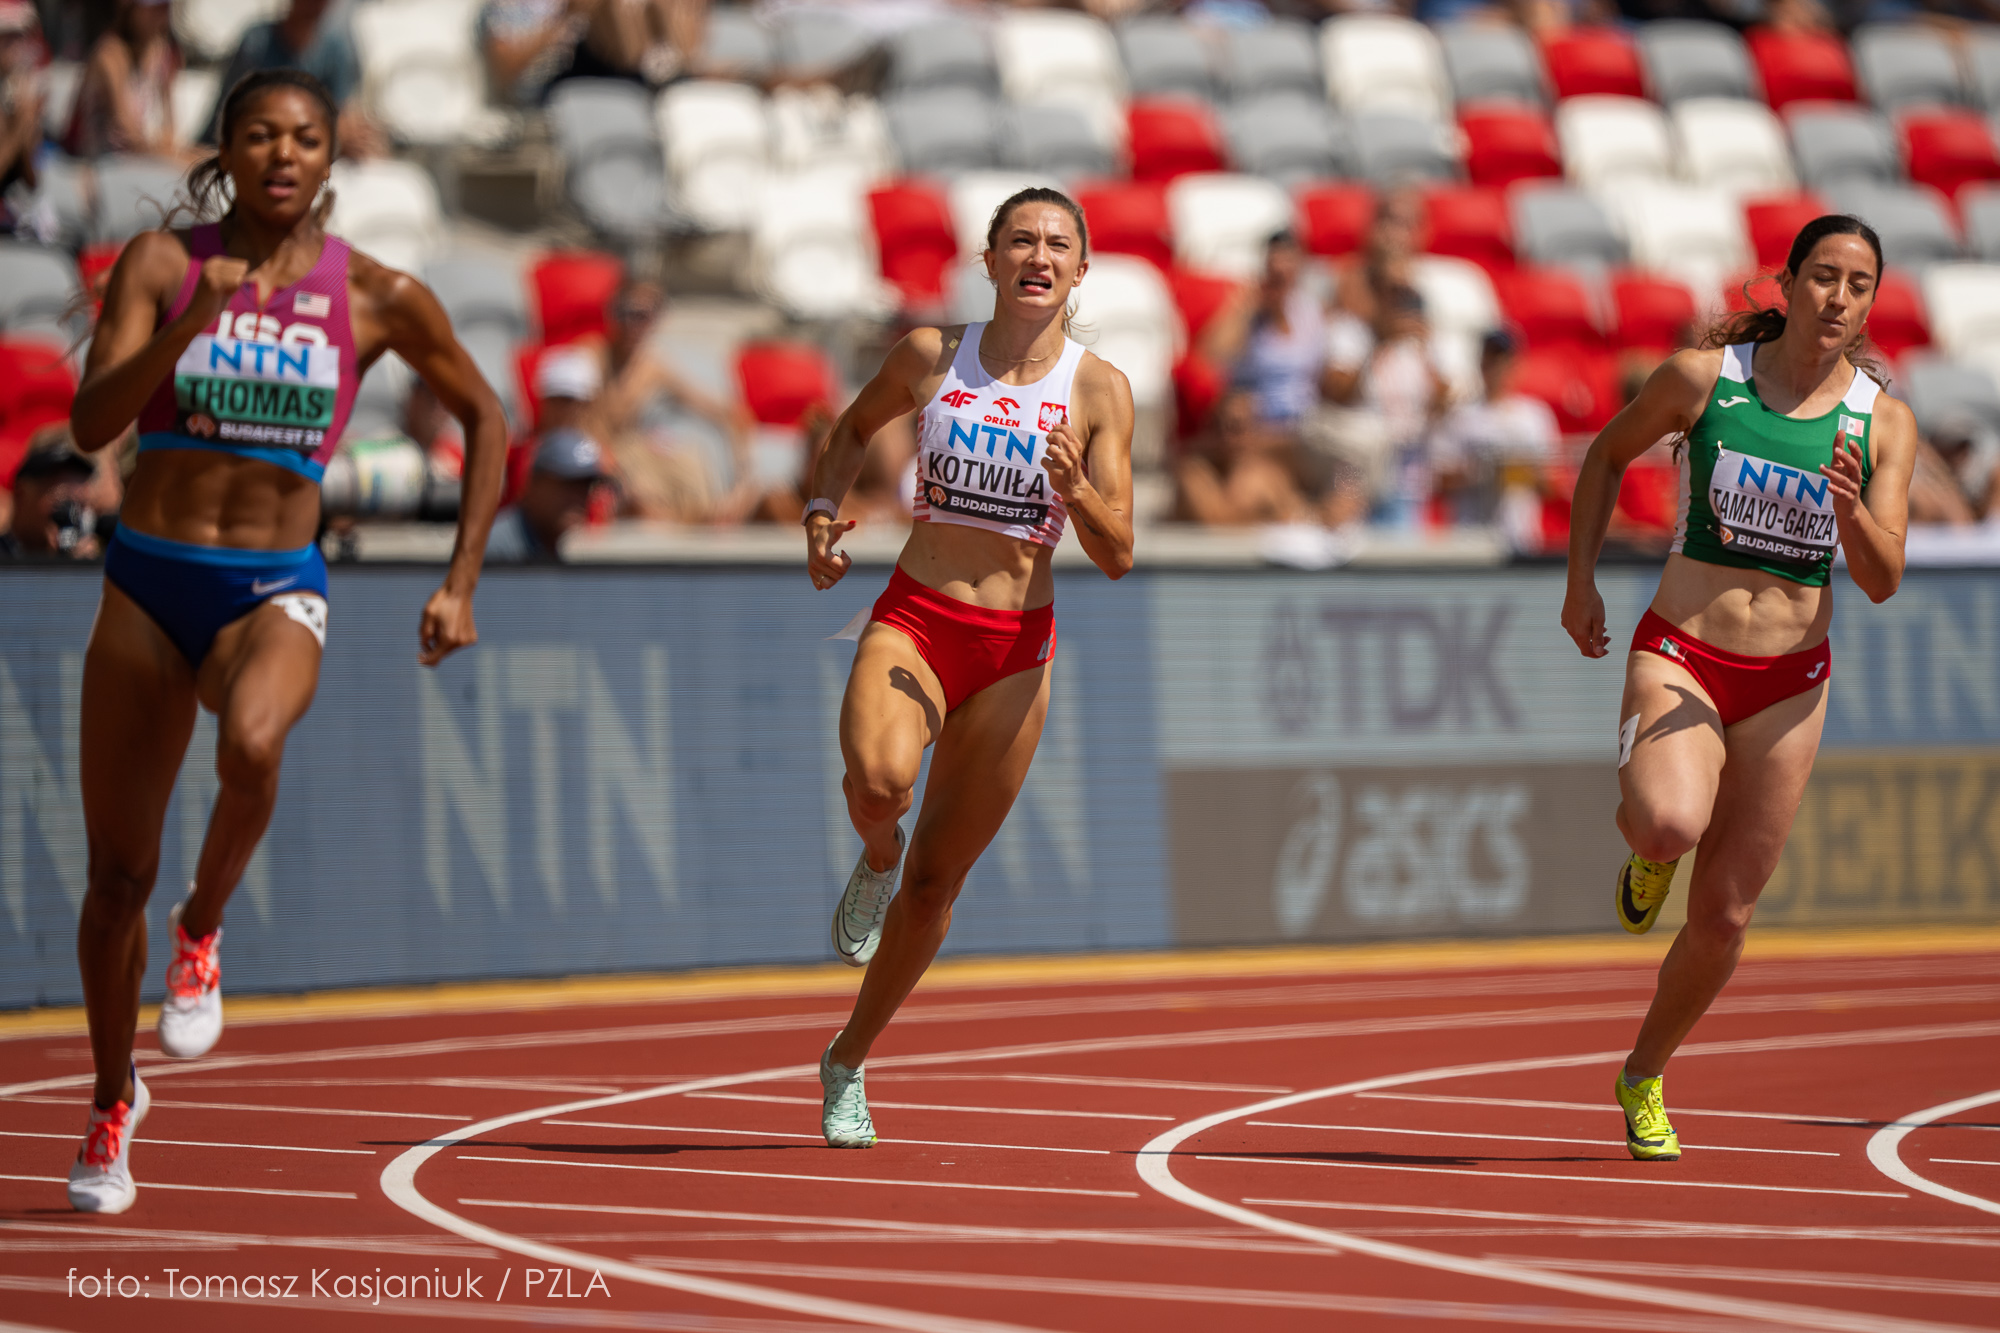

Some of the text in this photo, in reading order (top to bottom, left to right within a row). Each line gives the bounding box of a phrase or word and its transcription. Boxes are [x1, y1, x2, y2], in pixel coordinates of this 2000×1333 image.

[208, 337, 310, 383] NTN
[184, 376, 326, 421] THOMAS
[940, 389, 979, 409] 4F
[983, 415, 1020, 428] ORLEN
[948, 419, 1036, 466] NTN
[929, 451, 1045, 500] KOTWIŁA
[1737, 457, 1829, 508] NTN
[1712, 488, 1836, 542] TAMAYO-GARZA
[1319, 603, 1522, 734] TDK
[418, 645, 680, 916] NTN
